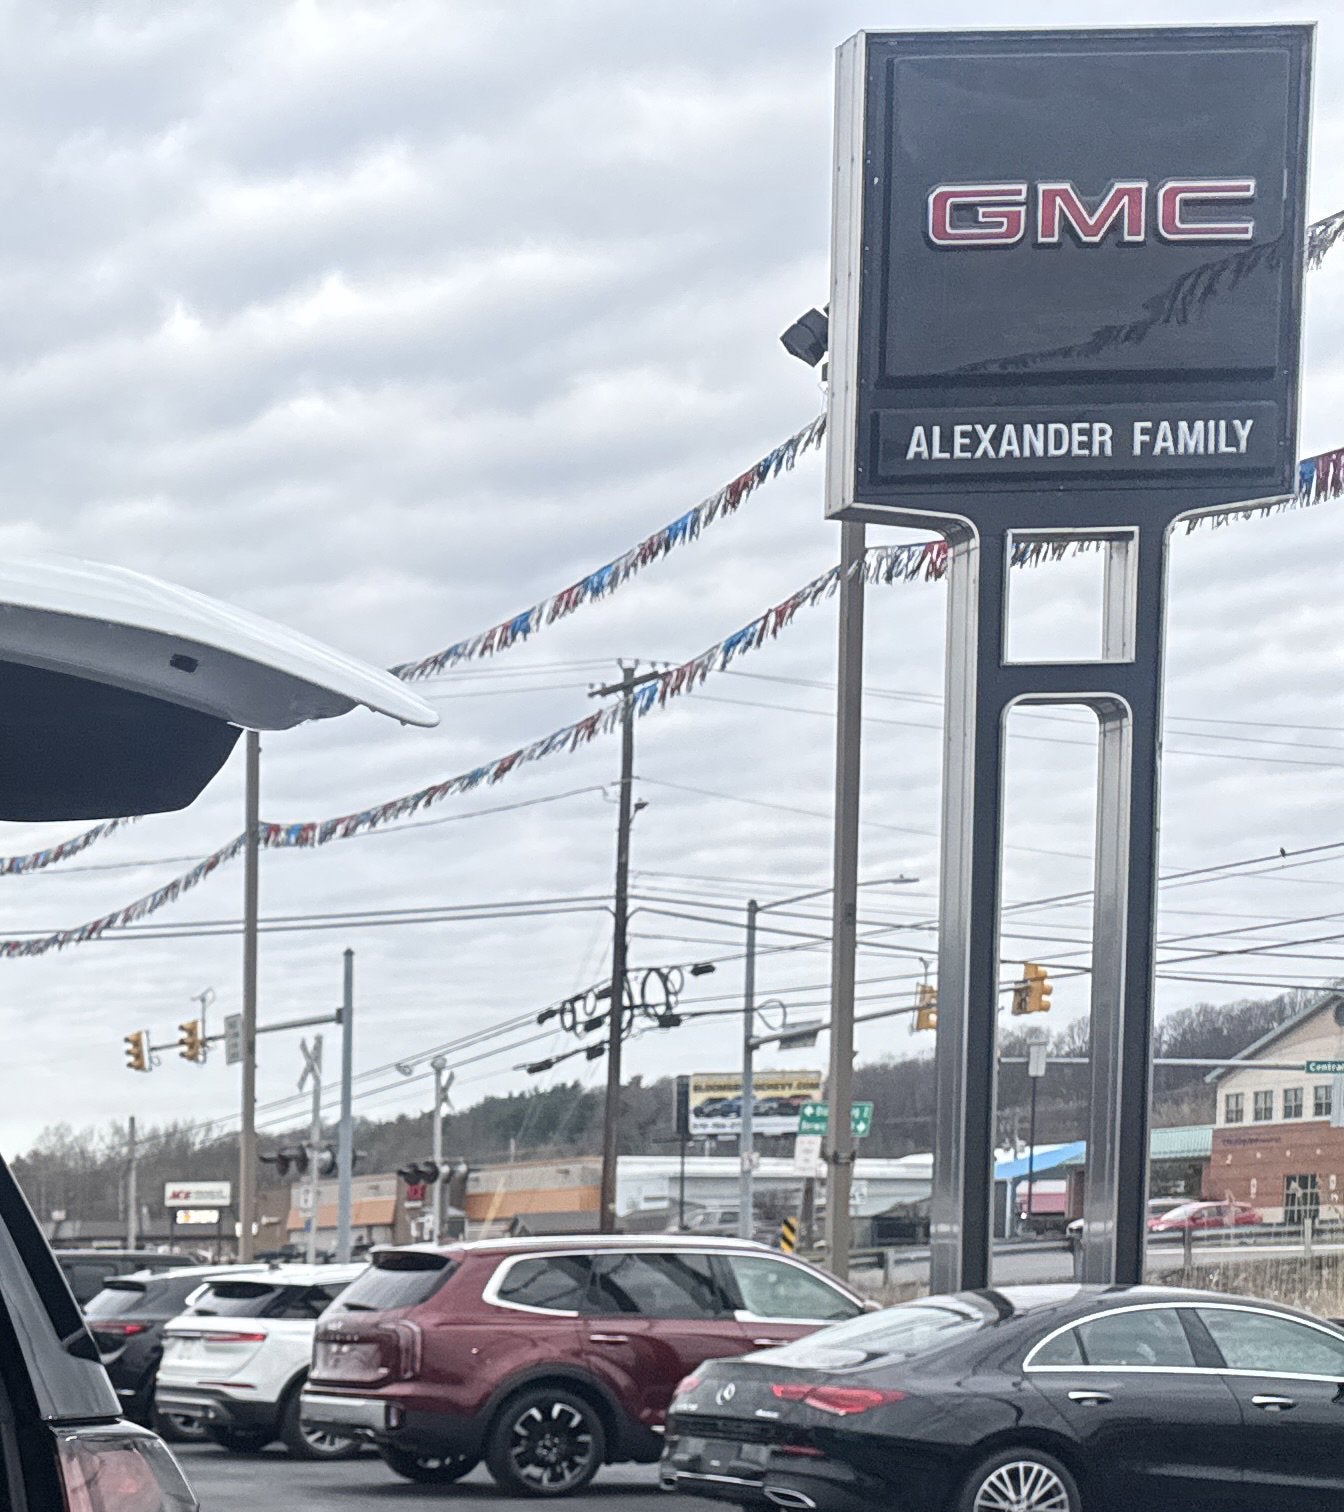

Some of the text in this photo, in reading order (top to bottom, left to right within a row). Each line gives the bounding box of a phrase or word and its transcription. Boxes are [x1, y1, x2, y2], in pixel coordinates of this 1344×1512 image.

[928, 180, 1256, 245] GMC
[906, 419, 1254, 460] ALEXANDER FAMILY
